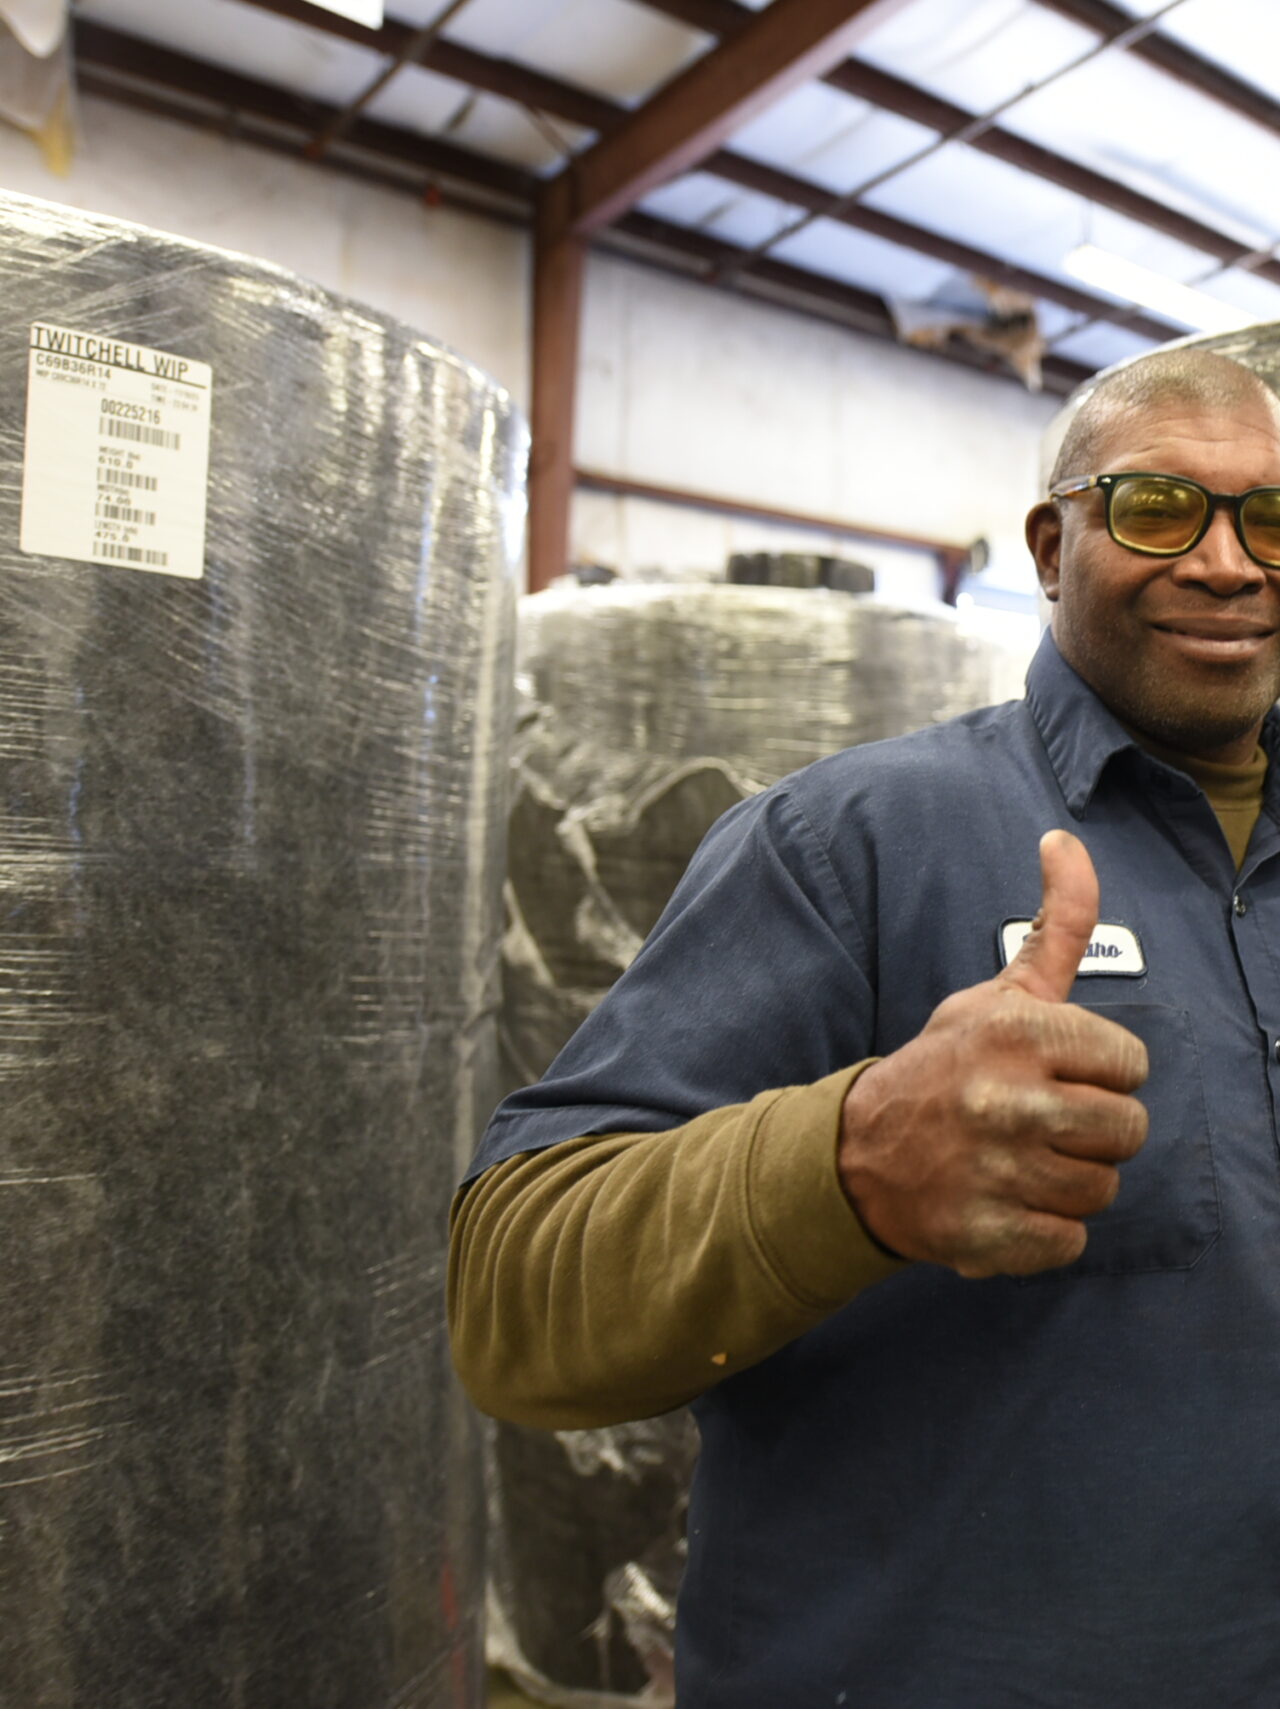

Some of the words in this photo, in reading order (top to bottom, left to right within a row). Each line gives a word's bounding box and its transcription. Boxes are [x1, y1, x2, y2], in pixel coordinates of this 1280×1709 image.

[33, 326, 145, 372] TWITCHELL
[153, 354, 189, 381] WIP
[101, 398, 161, 425] 00225216
